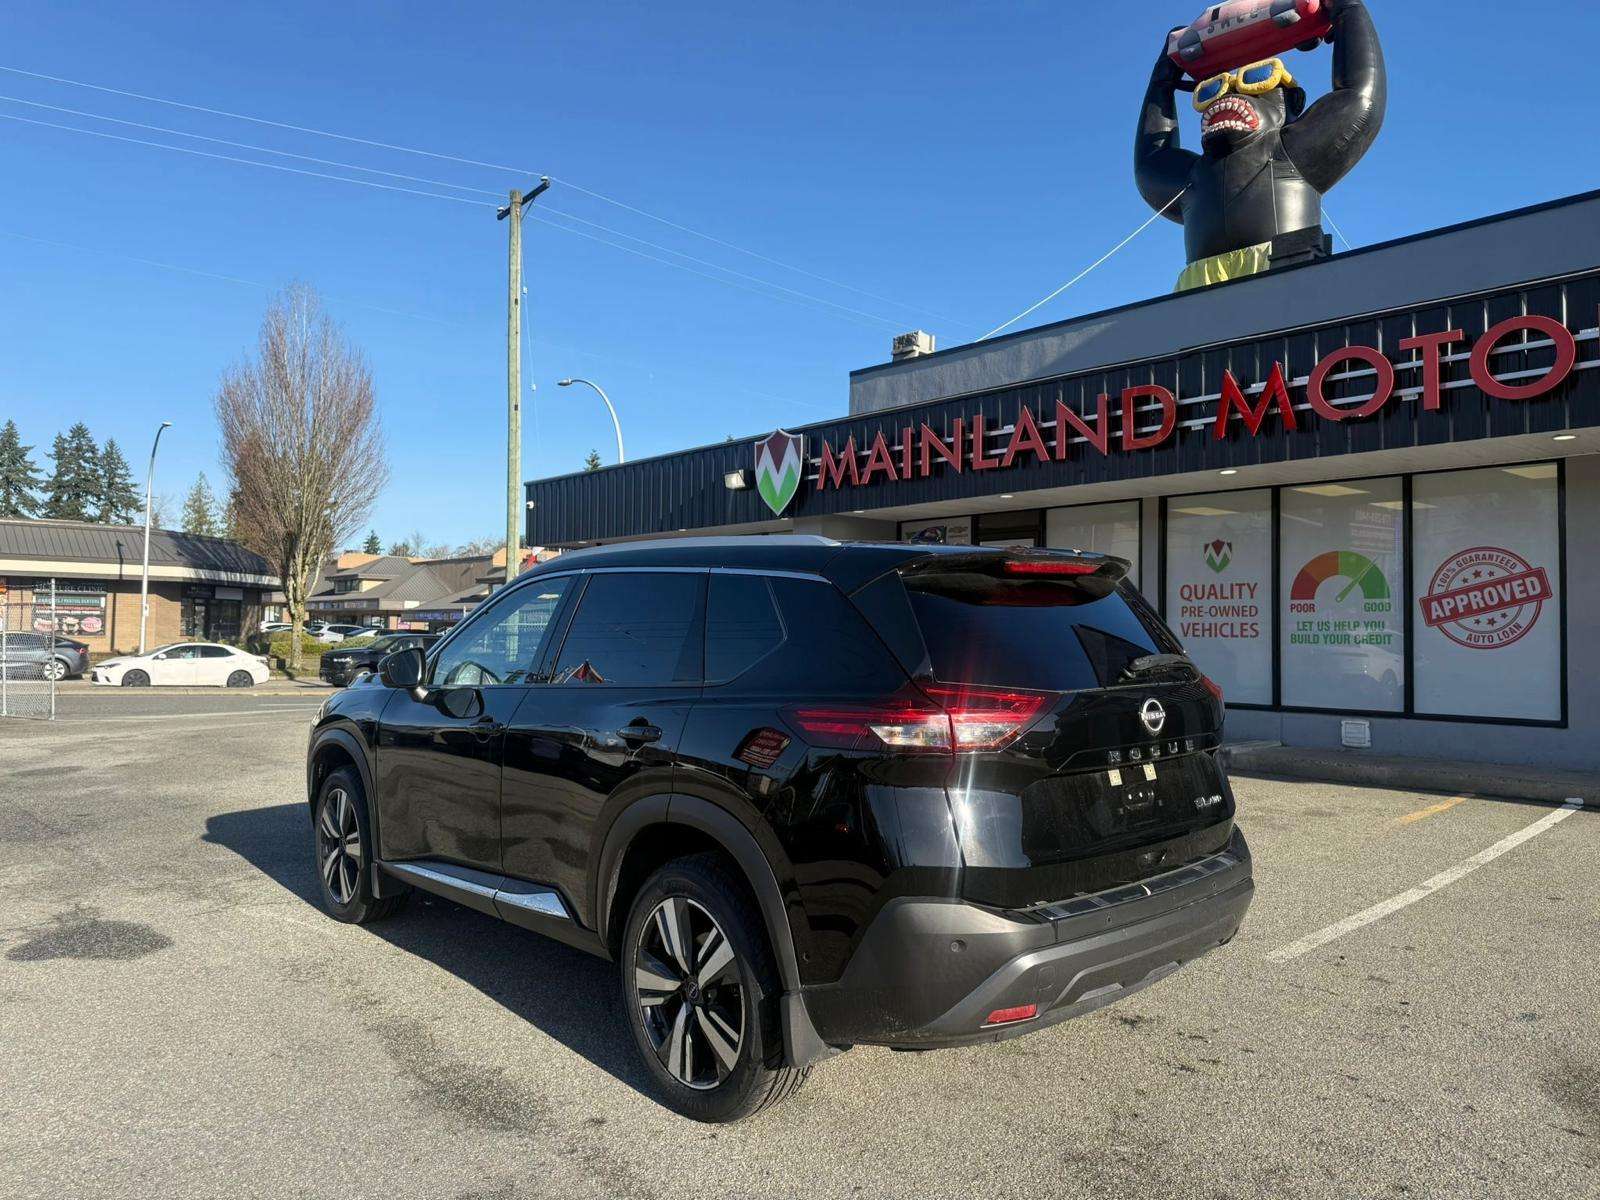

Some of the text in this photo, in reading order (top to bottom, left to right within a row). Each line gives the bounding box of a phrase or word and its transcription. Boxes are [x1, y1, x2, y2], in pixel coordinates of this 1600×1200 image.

[816, 303, 1600, 491] MAINLAND MOTO
[1437, 553, 1518, 589] 100% GUARANTEED
[1179, 582, 1259, 602] QUALITY
[1430, 576, 1542, 620] APPROVED
[1181, 605, 1259, 618] PRE-OWNED
[1290, 602, 1316, 613] POOR
[1363, 601, 1392, 612] GOOD
[1181, 622, 1260, 639] VEHICLES
[1296, 620, 1385, 631] LET US HELP YOU
[1466, 622, 1523, 644] AUTO LOAN
[1290, 633, 1393, 645] BUILD YOUR CREDIT
[1109, 740, 1195, 762] ROGUE
